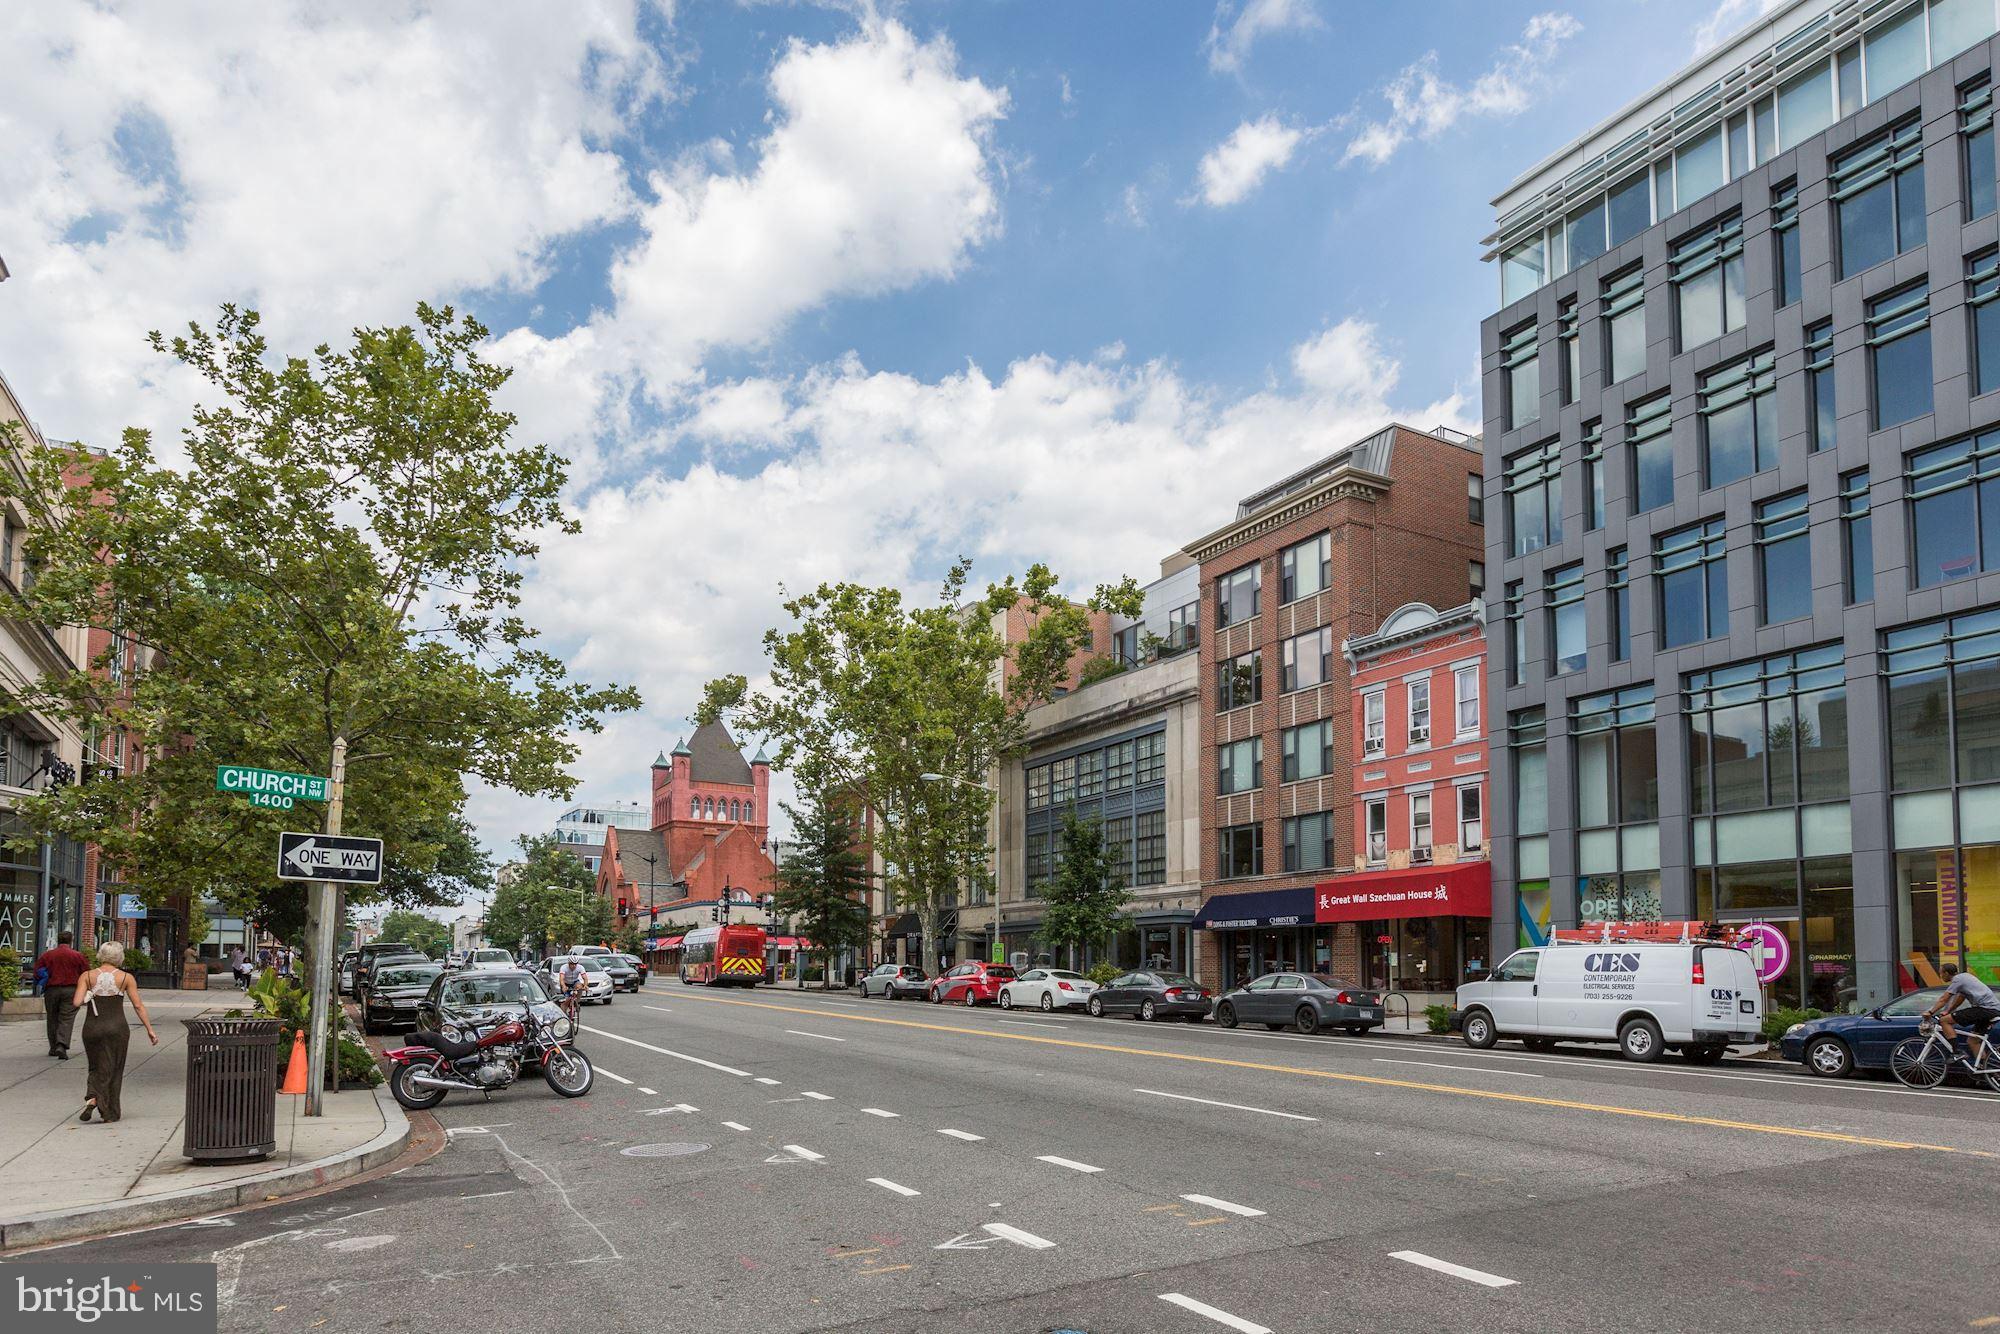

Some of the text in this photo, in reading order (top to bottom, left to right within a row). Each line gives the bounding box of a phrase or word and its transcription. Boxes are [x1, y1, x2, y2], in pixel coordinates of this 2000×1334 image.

[223, 769, 322, 795] CHURCH ST
[309, 789, 322, 797] NW
[252, 793, 293, 809] 1400
[299, 849, 331, 865] ONE
[341, 852, 374, 867] WAY
[1331, 896, 1351, 906] Great
[1352, 894, 1368, 904] Wall
[1369, 892, 1406, 903] Szechuan
[1407, 890, 1433, 900] House
[1580, 898, 1633, 916] OPEN
[1377, 936, 1393, 944] OPEN
[21, 956, 33, 964] OFF
[1584, 953, 1641, 972] CES
[1584, 974, 1637, 983] CONTEMPORARY
[1612, 983, 1635, 991] SERVICES
[1602, 993, 1633, 1001] 255-9226
[1711, 989, 1733, 1001] CES
